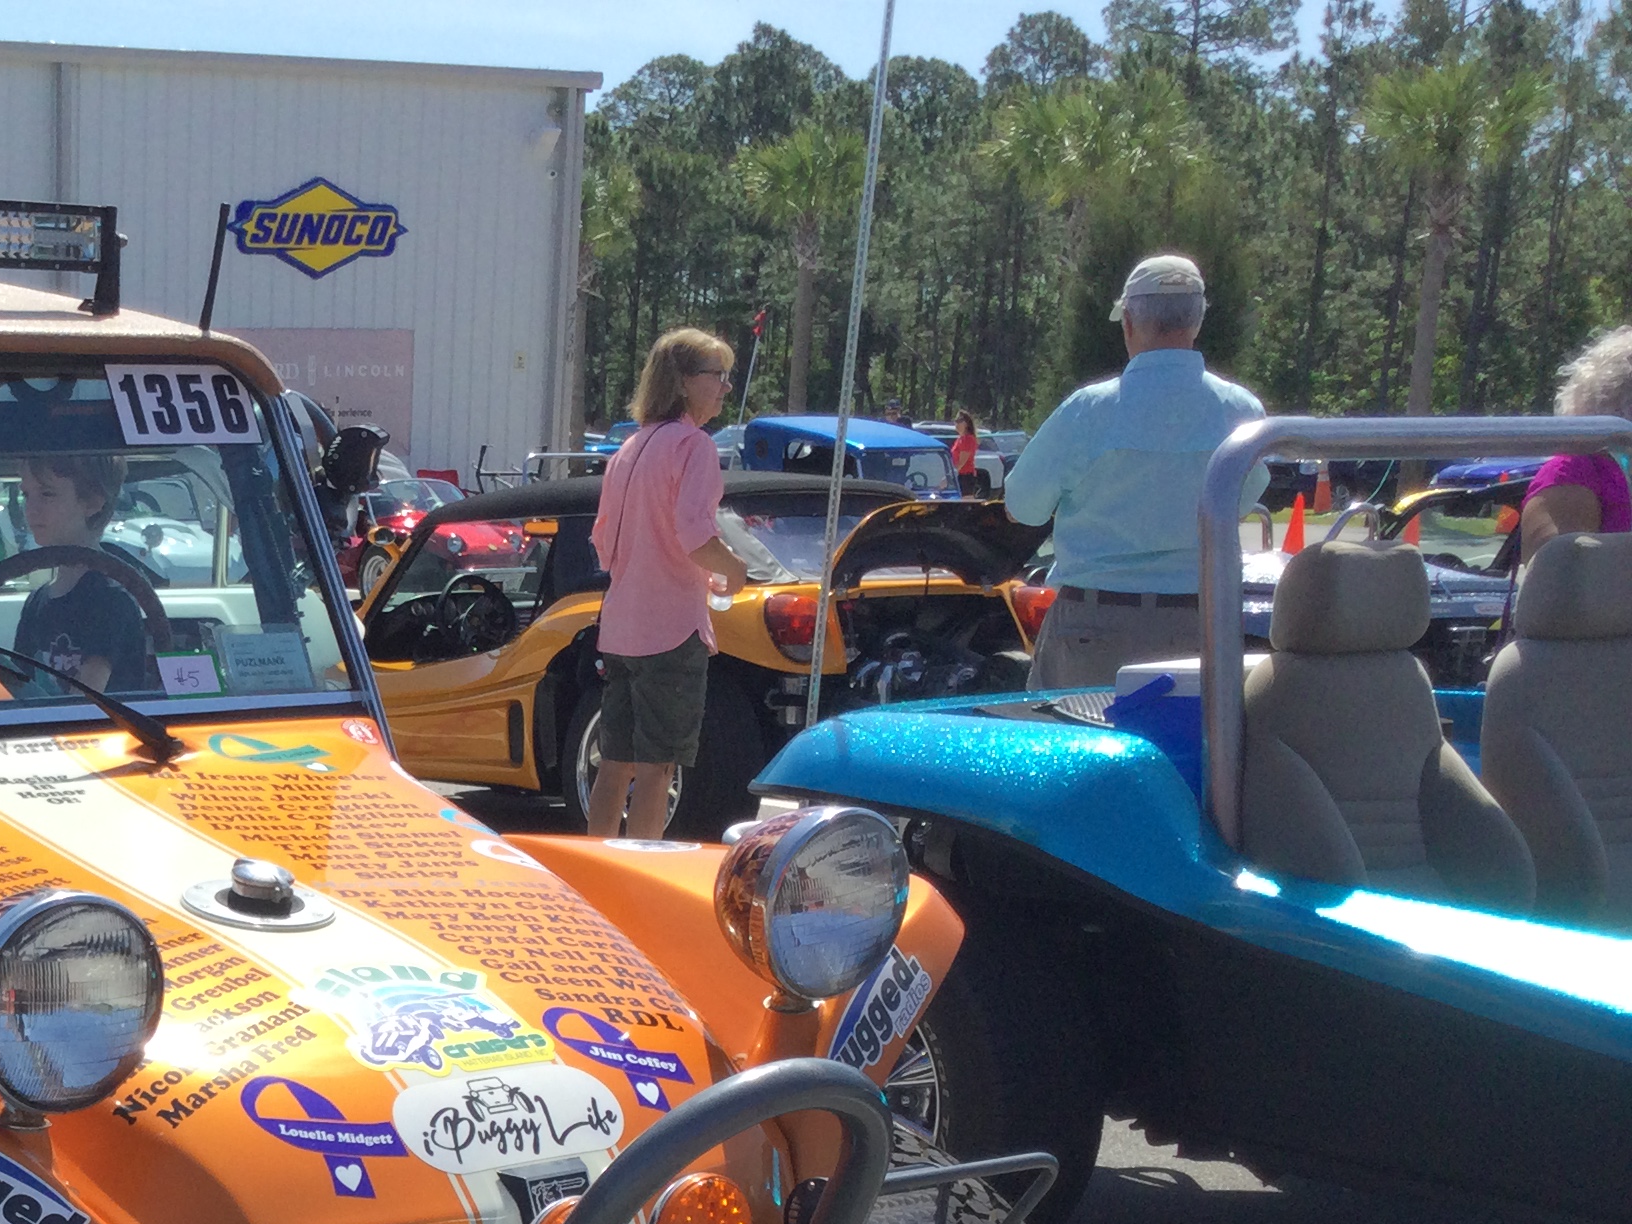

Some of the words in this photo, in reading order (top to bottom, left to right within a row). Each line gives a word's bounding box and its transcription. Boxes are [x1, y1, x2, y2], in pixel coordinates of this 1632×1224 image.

[250, 212, 394, 247] SUNOCO
[323, 365, 405, 377] LINCOLN
[118, 373, 249, 435] 1356
[174, 667, 200, 688] #5
[196, 771, 269, 782] Irene
[272, 773, 387, 782] Wheeler
[16, 788, 86, 799] Honor
[183, 782, 266, 791] Diana
[270, 783, 352, 792] Miller
[170, 792, 264, 802] Wilma
[176, 803, 272, 812] Denise
[276, 801, 419, 813] Creighton
[181, 812, 281, 823] Phyllis
[210, 822, 305, 832] Donna
[314, 821, 409, 831] Askew
[239, 832, 351, 842] Michele
[274, 842, 359, 852] Trina
[363, 840, 464, 850] Stokes
[288, 852, 371, 861] Mona
[310, 862, 389, 872] Patty
[354, 870, 459, 880] Shirley
[338, 888, 386, 898] Dr.
[387, 888, 458, 899] Rita
[359, 899, 513, 913] Katheryn
[379, 910, 460, 922] Mary
[465, 911, 540, 923] Beth
[428, 921, 519, 935] Jenny
[436, 932, 553, 947] Crystal
[456, 944, 516, 959] Gay
[522, 947, 589, 962] Nell
[479, 957, 547, 972] Gail
[550, 964, 609, 977] and
[313, 965, 478, 998] sland
[499, 971, 606, 989] Coleen
[533, 987, 645, 1008] Sandra
[894, 973, 931, 1033] radios
[193, 988, 282, 1034] ackson
[598, 1006, 685, 1033] RDL
[442, 1033, 547, 1059] cruisers
[461, 1055, 504, 1067] HATTERAS
[589, 1045, 624, 1062] Jim
[625, 1053, 678, 1073] Coffey
[156, 1057, 260, 1129] Marsha
[251, 1024, 318, 1063] Fred
[533, 1095, 618, 1146] Life
[278, 1123, 336, 1142] Louelle
[336, 1130, 394, 1147] Midgett
